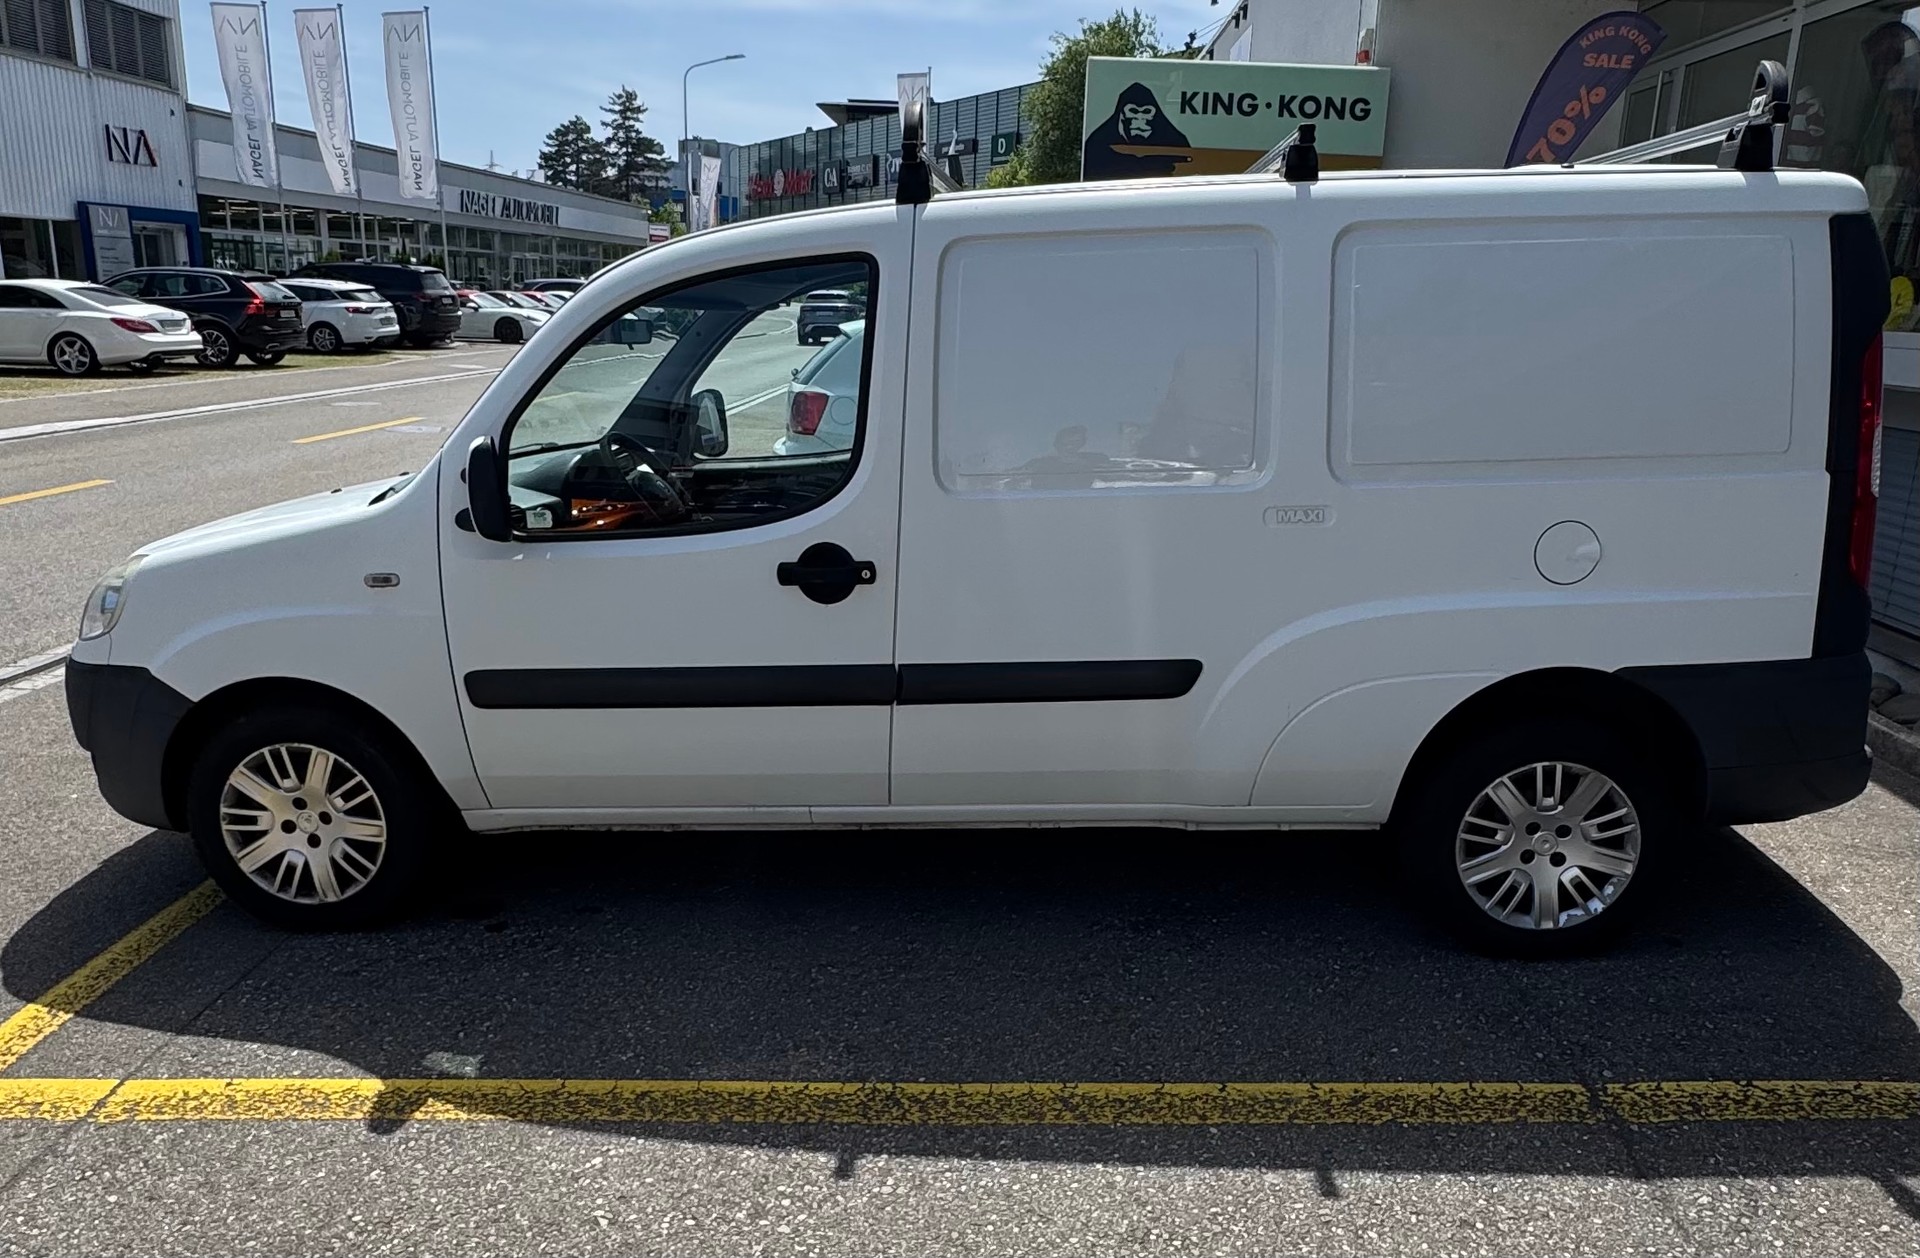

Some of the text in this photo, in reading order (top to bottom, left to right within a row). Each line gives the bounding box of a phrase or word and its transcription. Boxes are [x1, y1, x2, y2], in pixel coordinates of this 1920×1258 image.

[1579, 25, 1651, 55] KING KONG
[1583, 53, 1635, 69] SALE
[1526, 84, 1607, 163] 70%
[1277, 508, 1325, 523] MAXI
